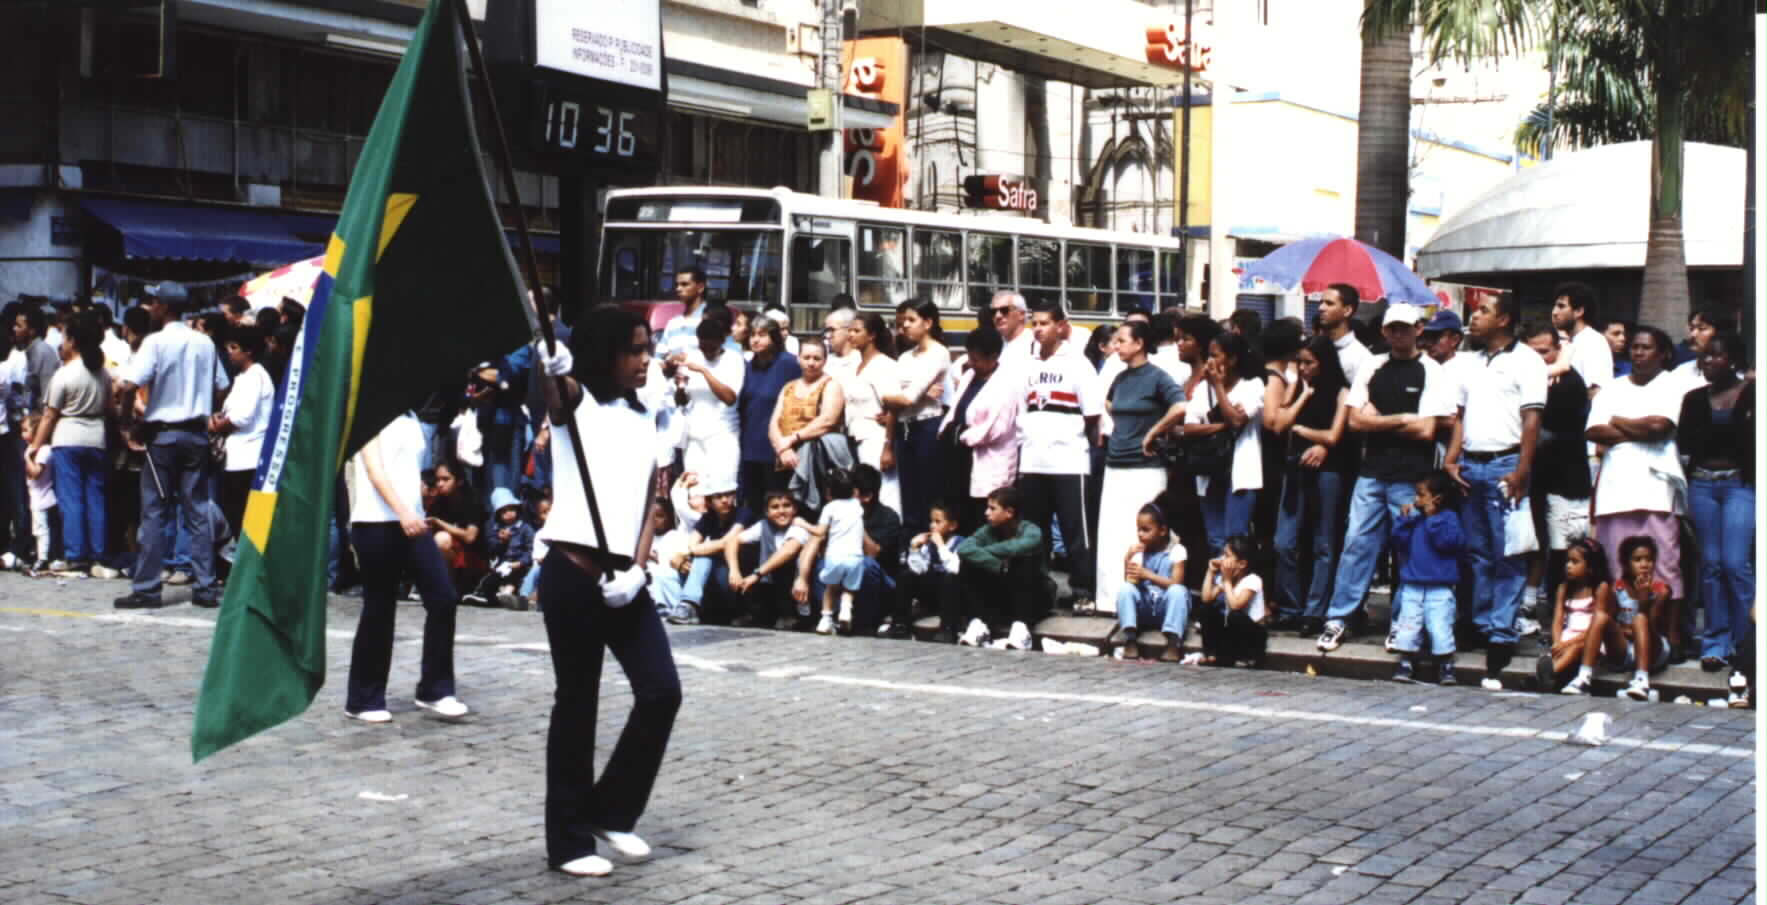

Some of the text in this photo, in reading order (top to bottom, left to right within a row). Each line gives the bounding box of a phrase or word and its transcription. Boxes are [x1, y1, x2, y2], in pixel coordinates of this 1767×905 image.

[545, 101, 635, 156] 10 36
[998, 175, 1037, 210] Safra
[267, 367, 300, 487] PROGRESSO
